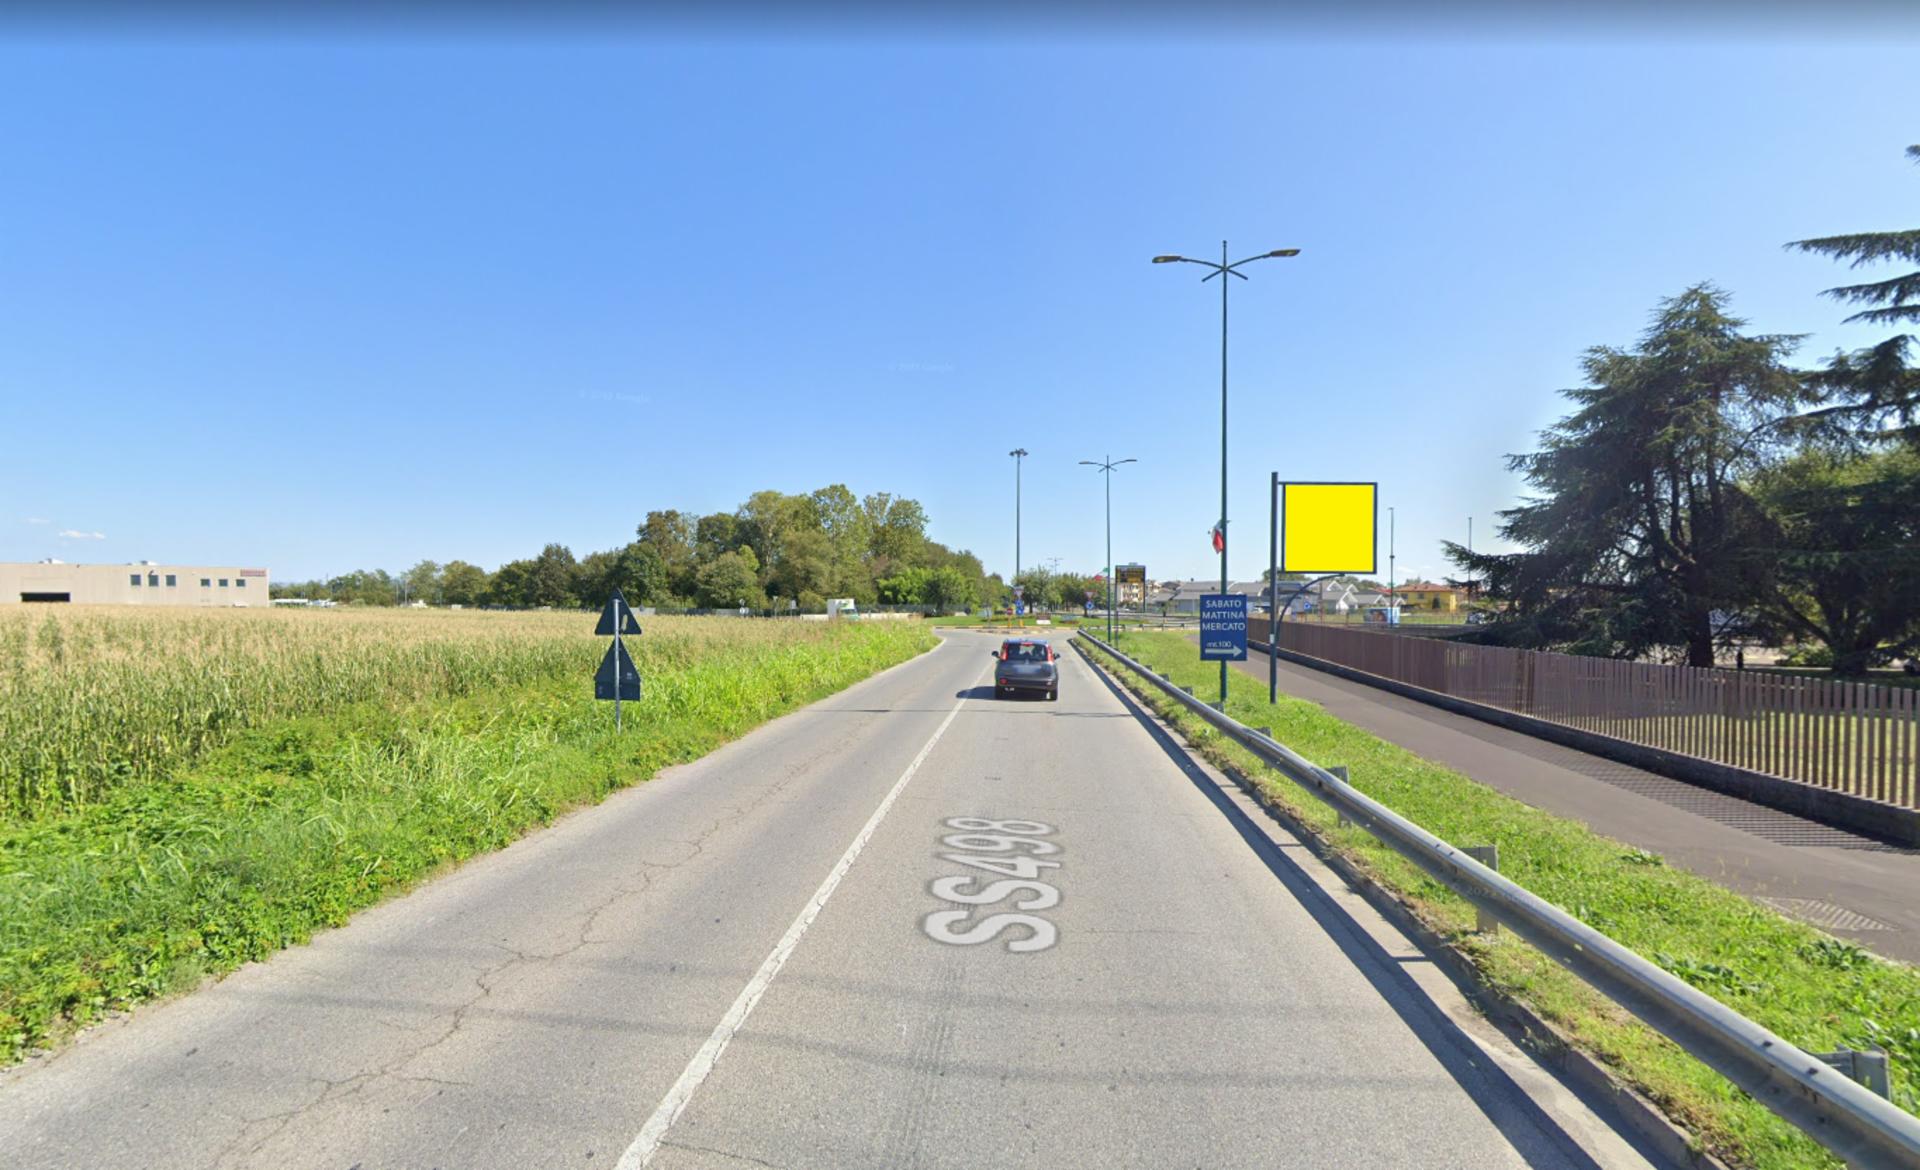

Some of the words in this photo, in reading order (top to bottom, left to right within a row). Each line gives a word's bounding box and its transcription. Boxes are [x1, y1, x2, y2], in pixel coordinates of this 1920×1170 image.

[1206, 600, 1242, 608] SABATO
[1202, 611, 1245, 620] MATTINA
[1202, 622, 1246, 631] MERCATO
